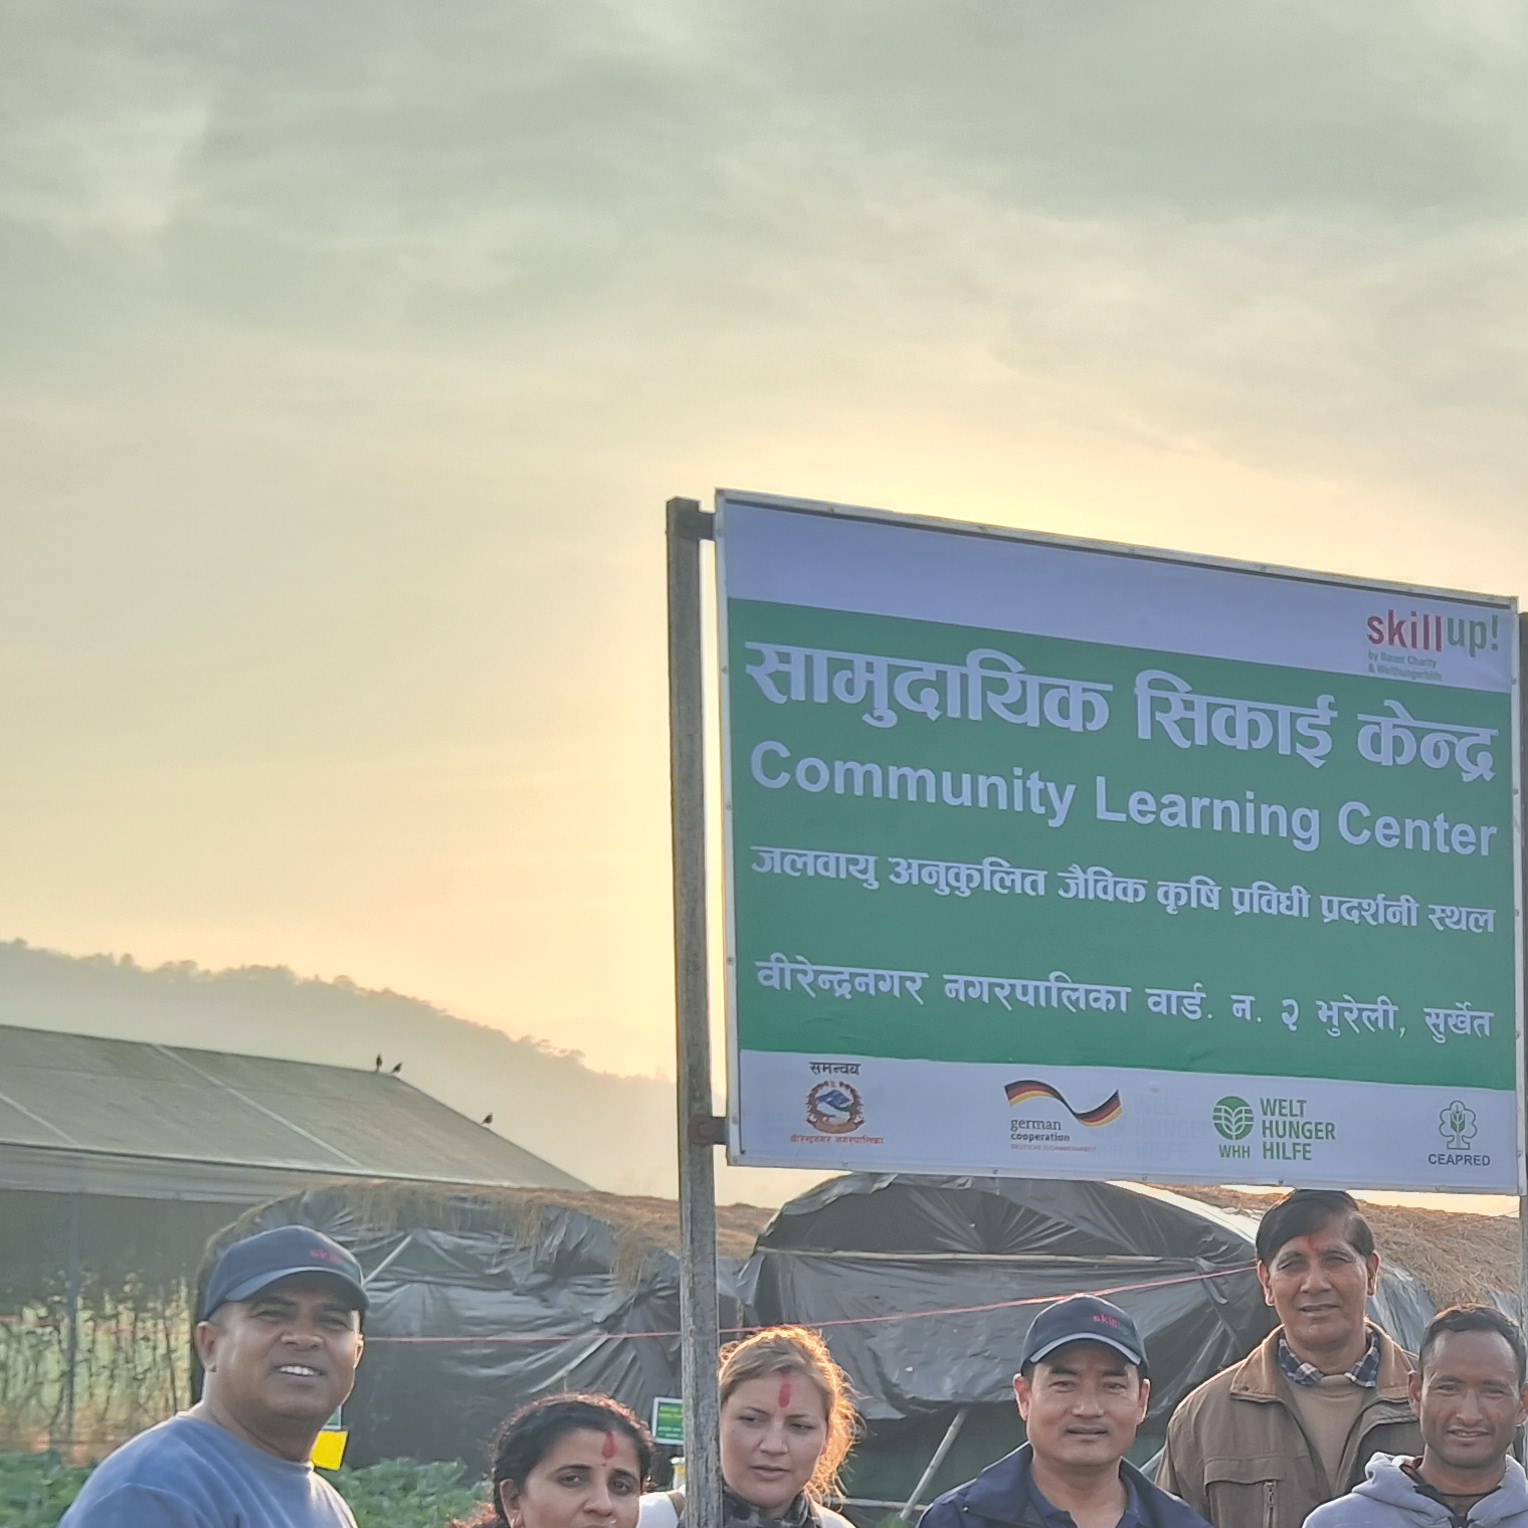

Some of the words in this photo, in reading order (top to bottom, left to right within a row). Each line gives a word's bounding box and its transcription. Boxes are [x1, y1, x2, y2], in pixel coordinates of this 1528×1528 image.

[744, 641, 1114, 732] सामुदायिक
[1133, 669, 1339, 769] सिकाई
[1356, 699, 1499, 783] केन्द्र
[750, 740, 1077, 828] Community
[1096, 775, 1321, 852] Learning
[1337, 801, 1499, 856] Center
[751, 845, 879, 890] जलवायु
[887, 856, 1048, 897] अनुकुलित
[1057, 863, 1149, 904] जैविक
[1156, 874, 1222, 914] कृषि
[1318, 893, 1420, 926] प्रदर्शनी
[1428, 903, 1497, 933] स्थल
[755, 951, 929, 1005] वीरेन्द्रनगर
[943, 970, 1132, 1013] नगरपालिका
[1424, 1001, 1495, 1044] सुर्खेत
[809, 1061, 861, 1075] समन्वय
[1260, 1098, 1307, 1118] WELT
[1010, 1119, 1062, 1132] german
[1262, 1119, 1336, 1141] HUNGER
[1011, 1132, 1070, 1143] cooperation
[1218, 1144, 1251, 1159] WHH
[1262, 1141, 1312, 1161] HILFE
[1427, 1153, 1491, 1167] CEAPRED
